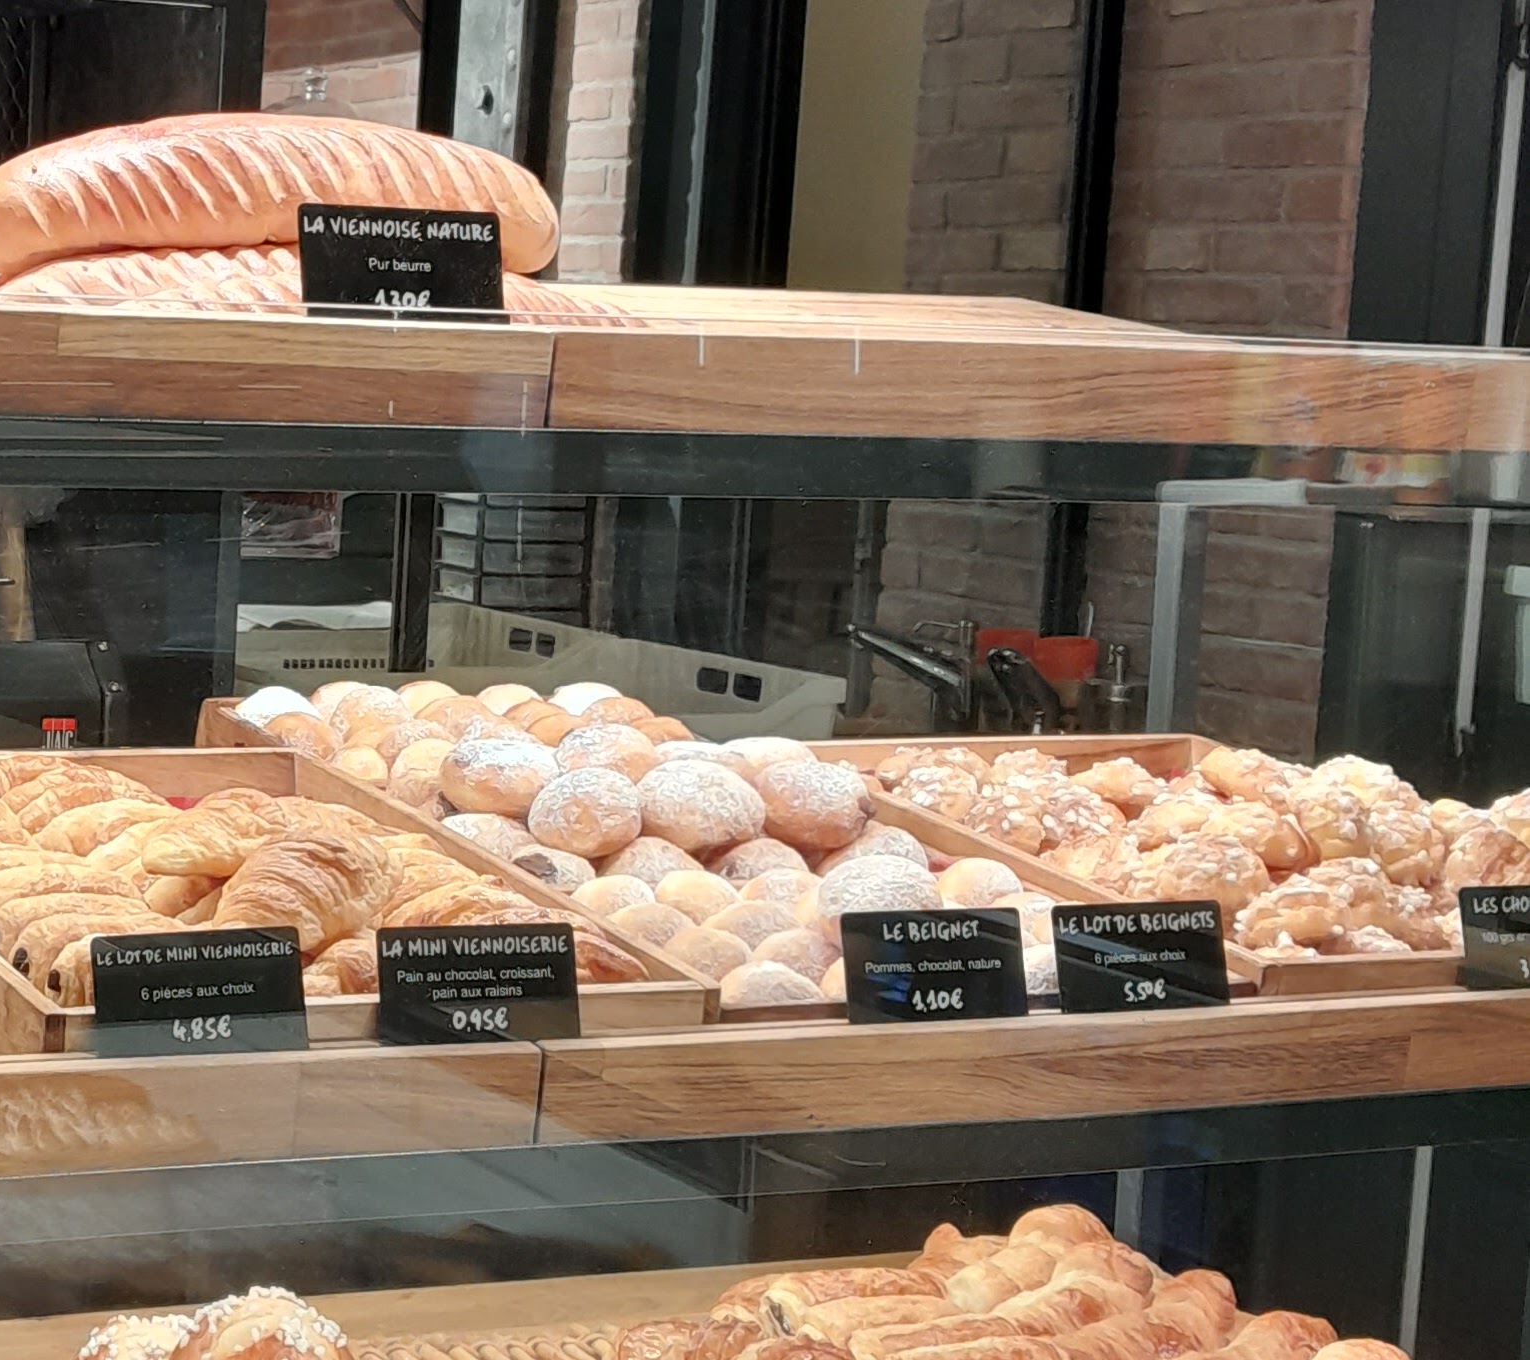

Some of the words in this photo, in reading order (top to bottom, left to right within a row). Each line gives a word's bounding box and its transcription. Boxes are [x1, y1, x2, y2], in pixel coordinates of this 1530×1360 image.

[303, 215, 325, 234] LA
[330, 216, 421, 240] VIENNOISE
[427, 221, 494, 242] NATURE
[369, 257, 389, 271] Pur
[393, 258, 432, 272] beurre
[1473, 897, 1498, 913] LES
[1502, 896, 1530, 913] CHO
[883, 922, 903, 942] LE
[908, 920, 980, 943] BEIGNET
[1059, 916, 1080, 935] LE
[1083, 914, 1111, 934] LOT
[1114, 913, 1137, 932] DE
[1140, 910, 1215, 933] BEIGNETS
[97, 951, 113, 966] LE
[117, 949, 141, 965] LOT
[143, 948, 162, 963] DE
[166, 946, 197, 961] MINI
[202, 941, 294, 959] VIENNOISERIE
[382, 941, 403, 957] LA
[408, 938, 447, 957] MINI
[453, 934, 568, 955] VIENNOISERIE
[1094, 953, 1102, 965] 6
[1139, 951, 1157, 963] aux
[1160, 948, 1186, 961] choix
[397, 970, 423, 983] Pain
[427, 971, 441, 982] au
[444, 967, 496, 982] chocolat,
[500, 965, 555, 981] croissant,
[968, 958, 1002, 970] nature
[141, 987, 149, 1001] 6
[197, 986, 219, 998] aux
[223, 981, 255, 996] choix
[432, 987, 458, 1001] pain
[461, 987, 482, 998] aux
[485, 985, 523, 998] raisins
[912, 987, 964, 1013] 1,10€
[1124, 978, 1166, 1003] 5,50€
[172, 1015, 232, 1042] 4,85€
[453, 1006, 509, 1032] 0,95€
